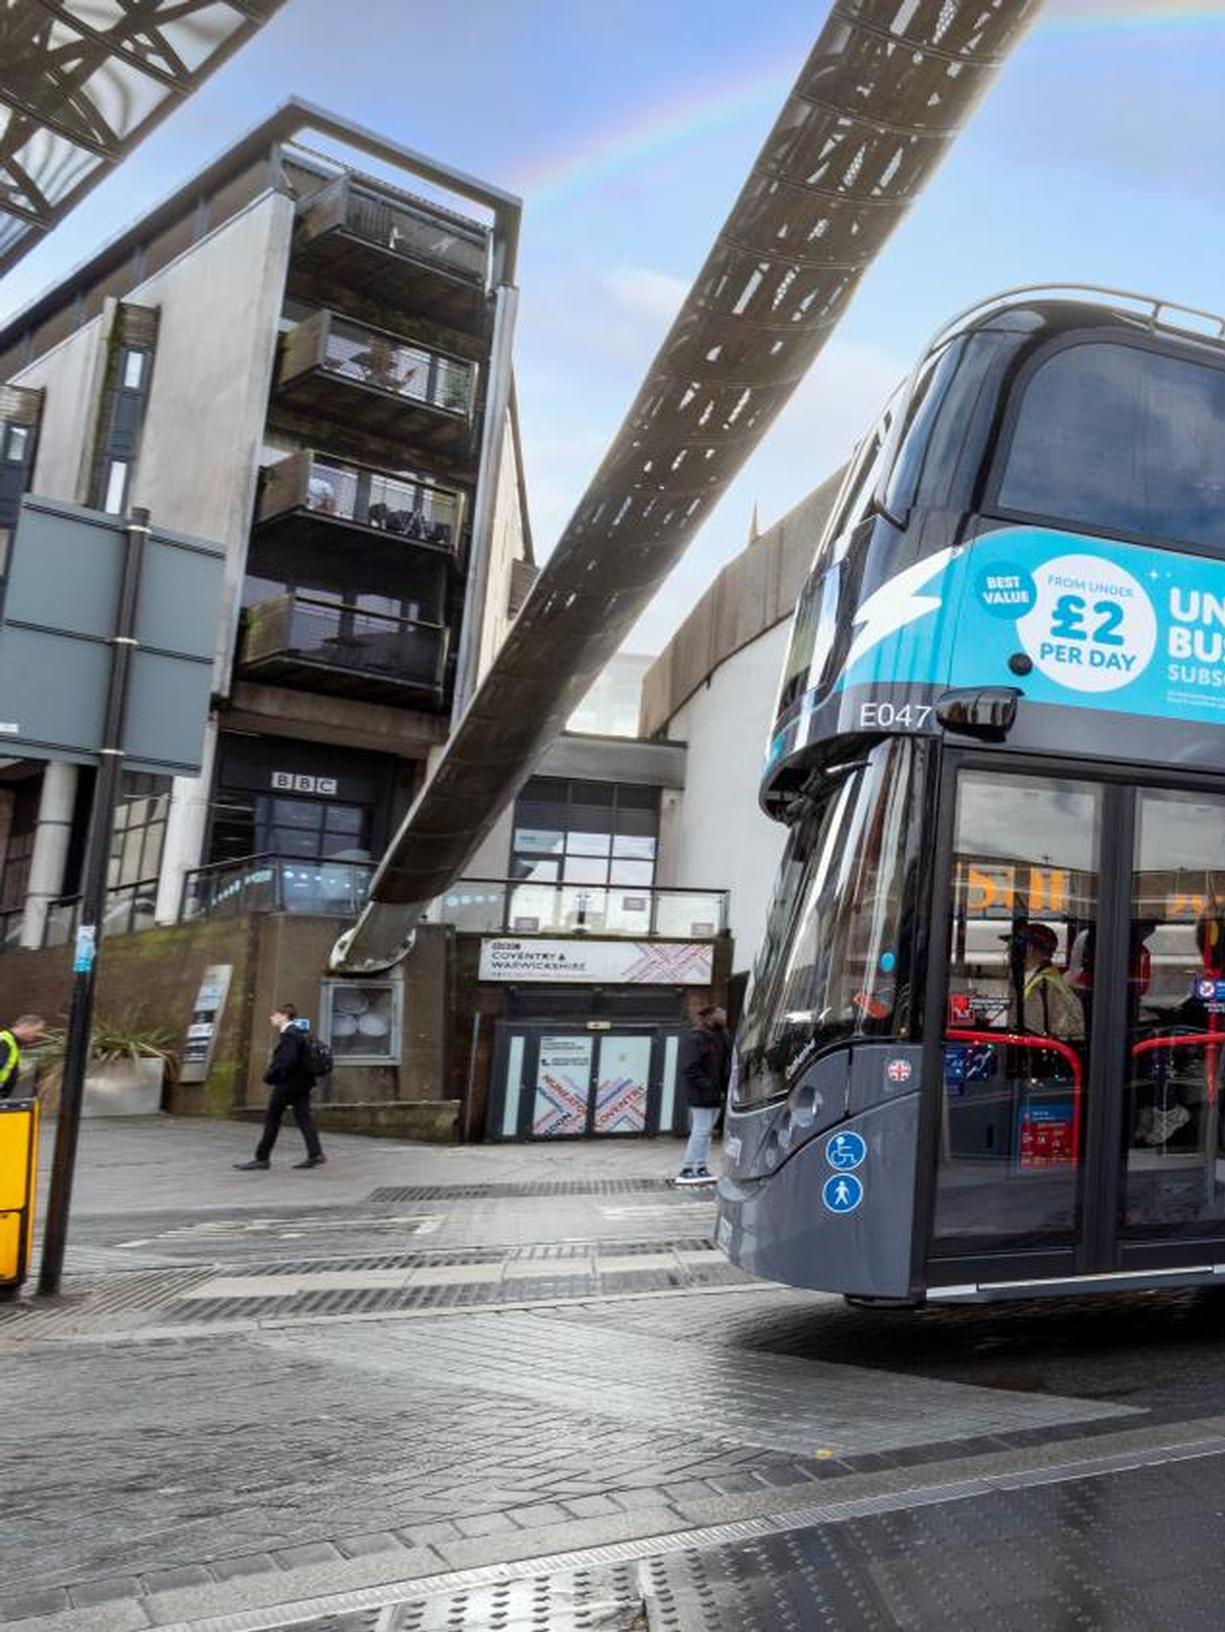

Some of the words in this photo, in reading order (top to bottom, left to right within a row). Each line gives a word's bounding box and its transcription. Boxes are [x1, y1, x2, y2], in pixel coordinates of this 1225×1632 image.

[986, 576, 1020, 589] BEST
[1047, 574, 1087, 591] FROM
[1089, 582, 1134, 598] UNDER
[983, 590, 1030, 604] VALUE
[1050, 594, 1125, 646] £2
[1040, 642, 1083, 665] PER
[1089, 650, 1138, 672] DAY
[859, 702, 932, 728] E047
[274, 773, 336, 794] BBC
[491, 951, 556, 960] COVENTRY
